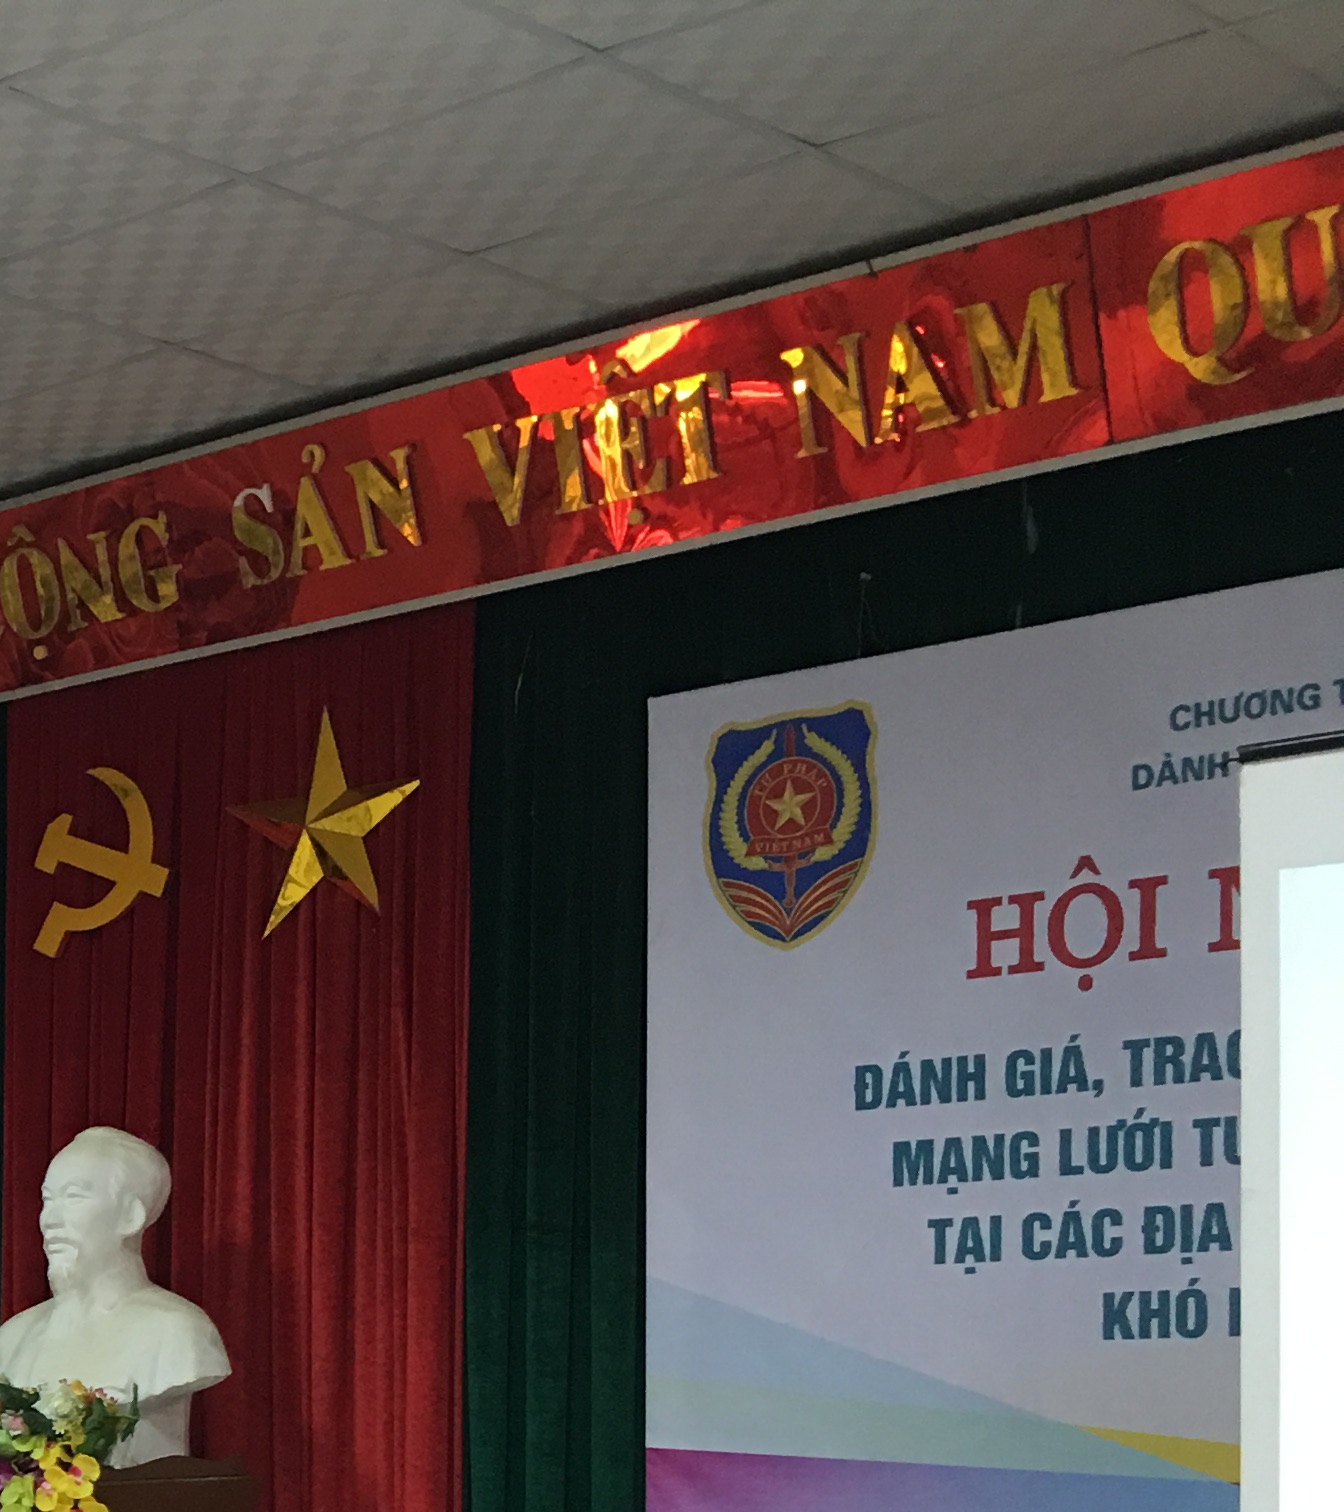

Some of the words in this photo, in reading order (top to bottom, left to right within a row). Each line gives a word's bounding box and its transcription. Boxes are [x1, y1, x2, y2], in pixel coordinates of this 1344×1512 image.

[232, 444, 421, 589] SẢN
[463, 361, 725, 526] VIỆT
[780, 282, 1080, 458] NAM
[1170, 682, 1321, 731] CHƯƠNG
[1131, 752, 1230, 791] DÀNH
[966, 855, 1168, 992] HỘI
[854, 1050, 986, 1111] ĐÁNH
[1005, 1034, 1104, 1098] GIÁ,
[893, 1131, 1040, 1194] MẠNG
[1059, 1107, 1173, 1176] LƯỚI
[927, 1215, 1002, 1274] TẠI
[1021, 1200, 1123, 1260] CÁC
[1141, 1202, 1232, 1265] ĐỊA
[1102, 1278, 1208, 1340] KHÓ
